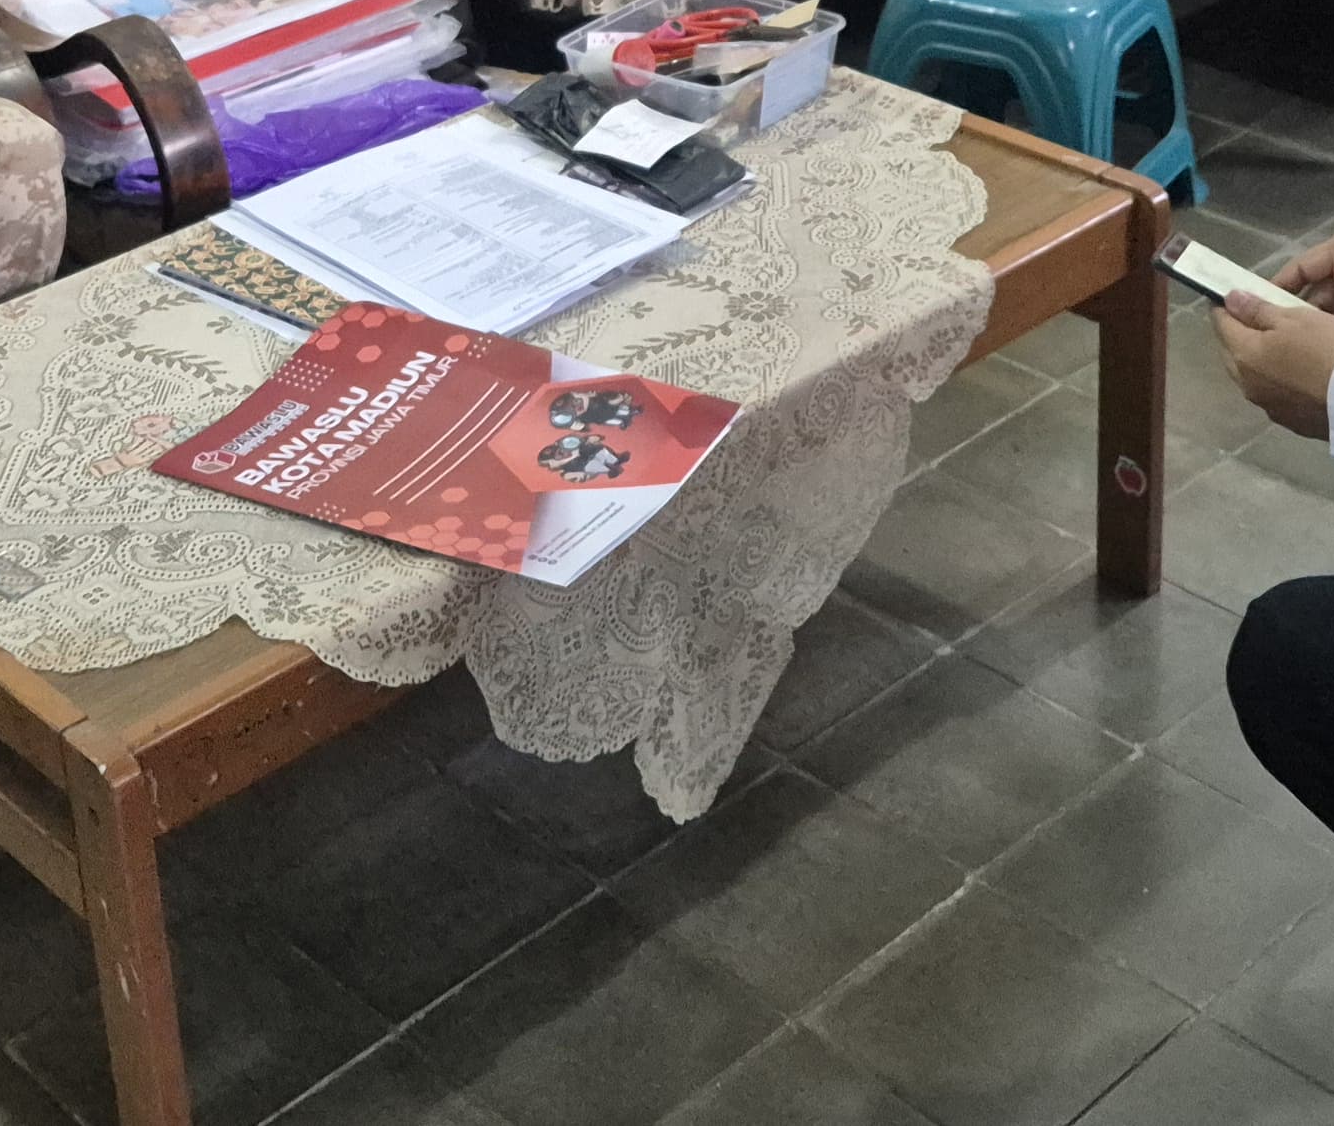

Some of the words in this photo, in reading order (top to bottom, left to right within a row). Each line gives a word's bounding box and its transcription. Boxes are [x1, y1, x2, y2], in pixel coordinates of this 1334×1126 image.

[221, 399, 298, 451] BAWASLU
[234, 386, 369, 486] BAWASLU
[261, 443, 345, 494] KOTA
[333, 350, 437, 442] MADIUN
[286, 443, 369, 500] PROVINSI
[365, 405, 415, 445] JAWA
[406, 355, 459, 401] TIMUR
